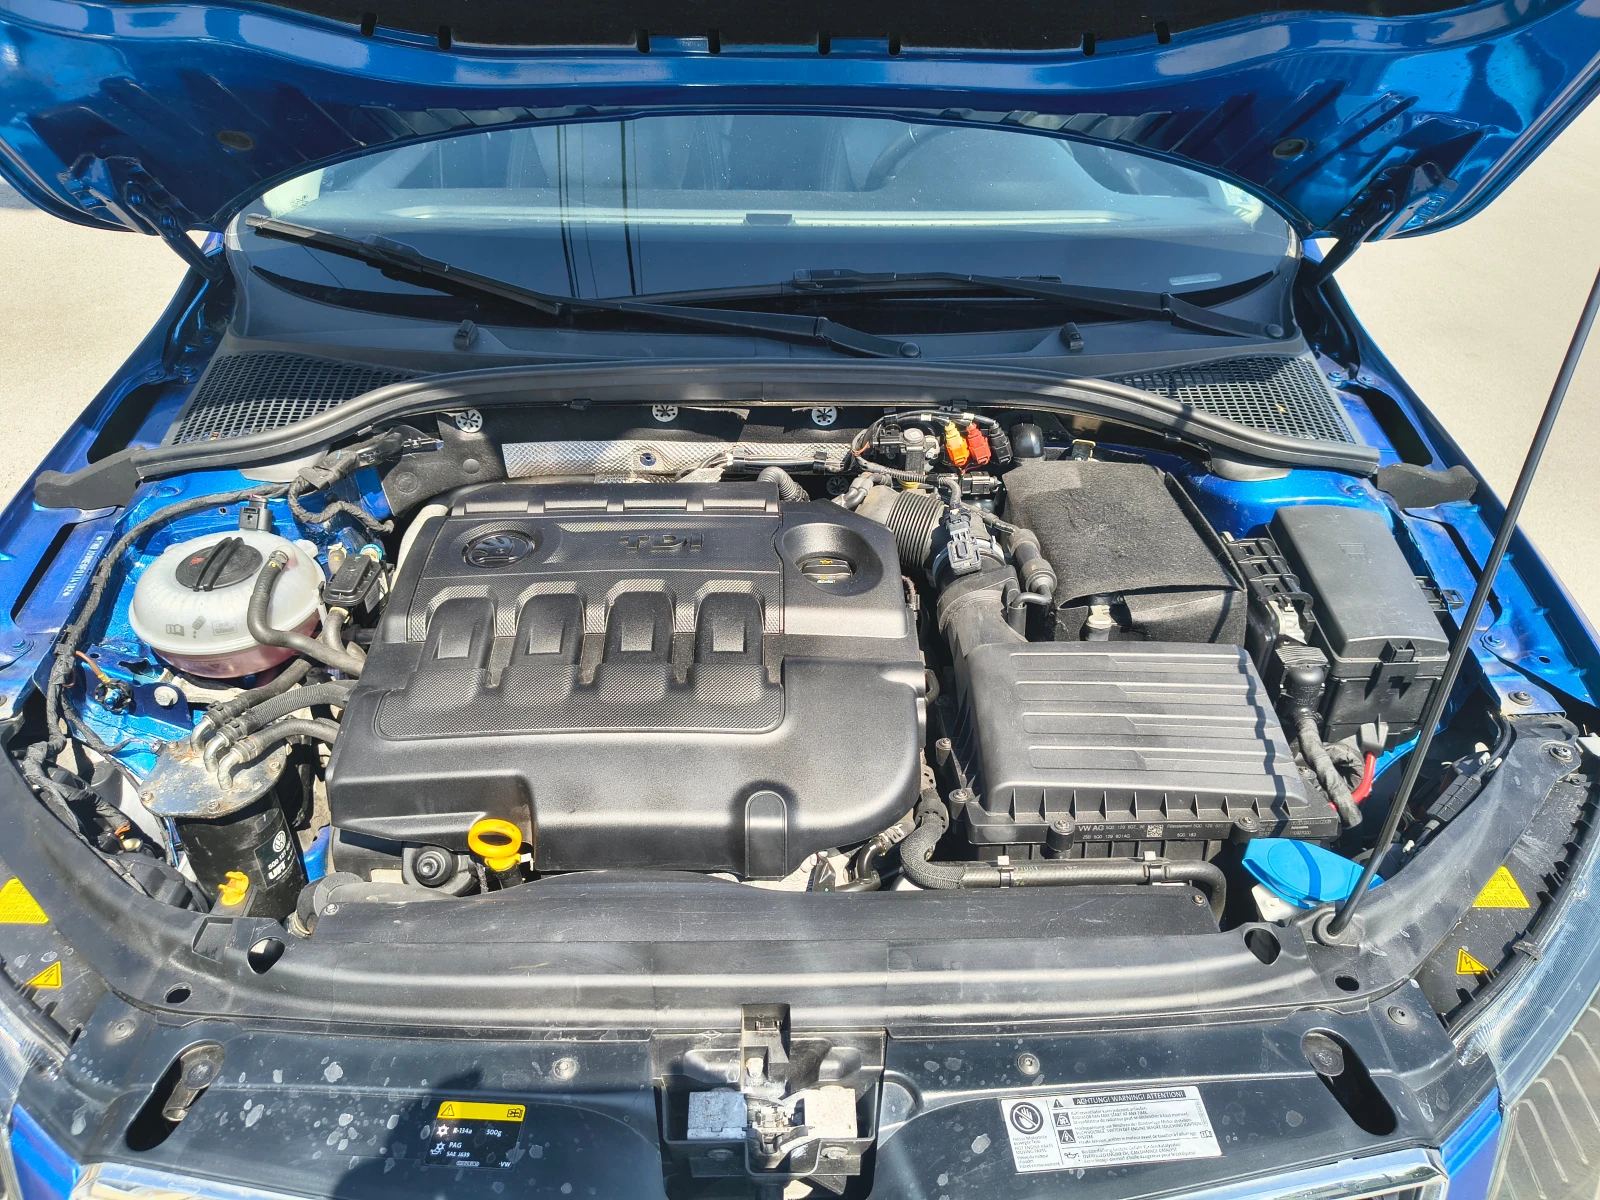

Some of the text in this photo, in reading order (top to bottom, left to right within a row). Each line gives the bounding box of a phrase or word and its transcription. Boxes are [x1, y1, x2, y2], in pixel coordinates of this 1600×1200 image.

[1076, 1090, 1184, 1105] ACHTUNG! WARNING! ATTENTION!
[486, 1128, 502, 1137] 500g
